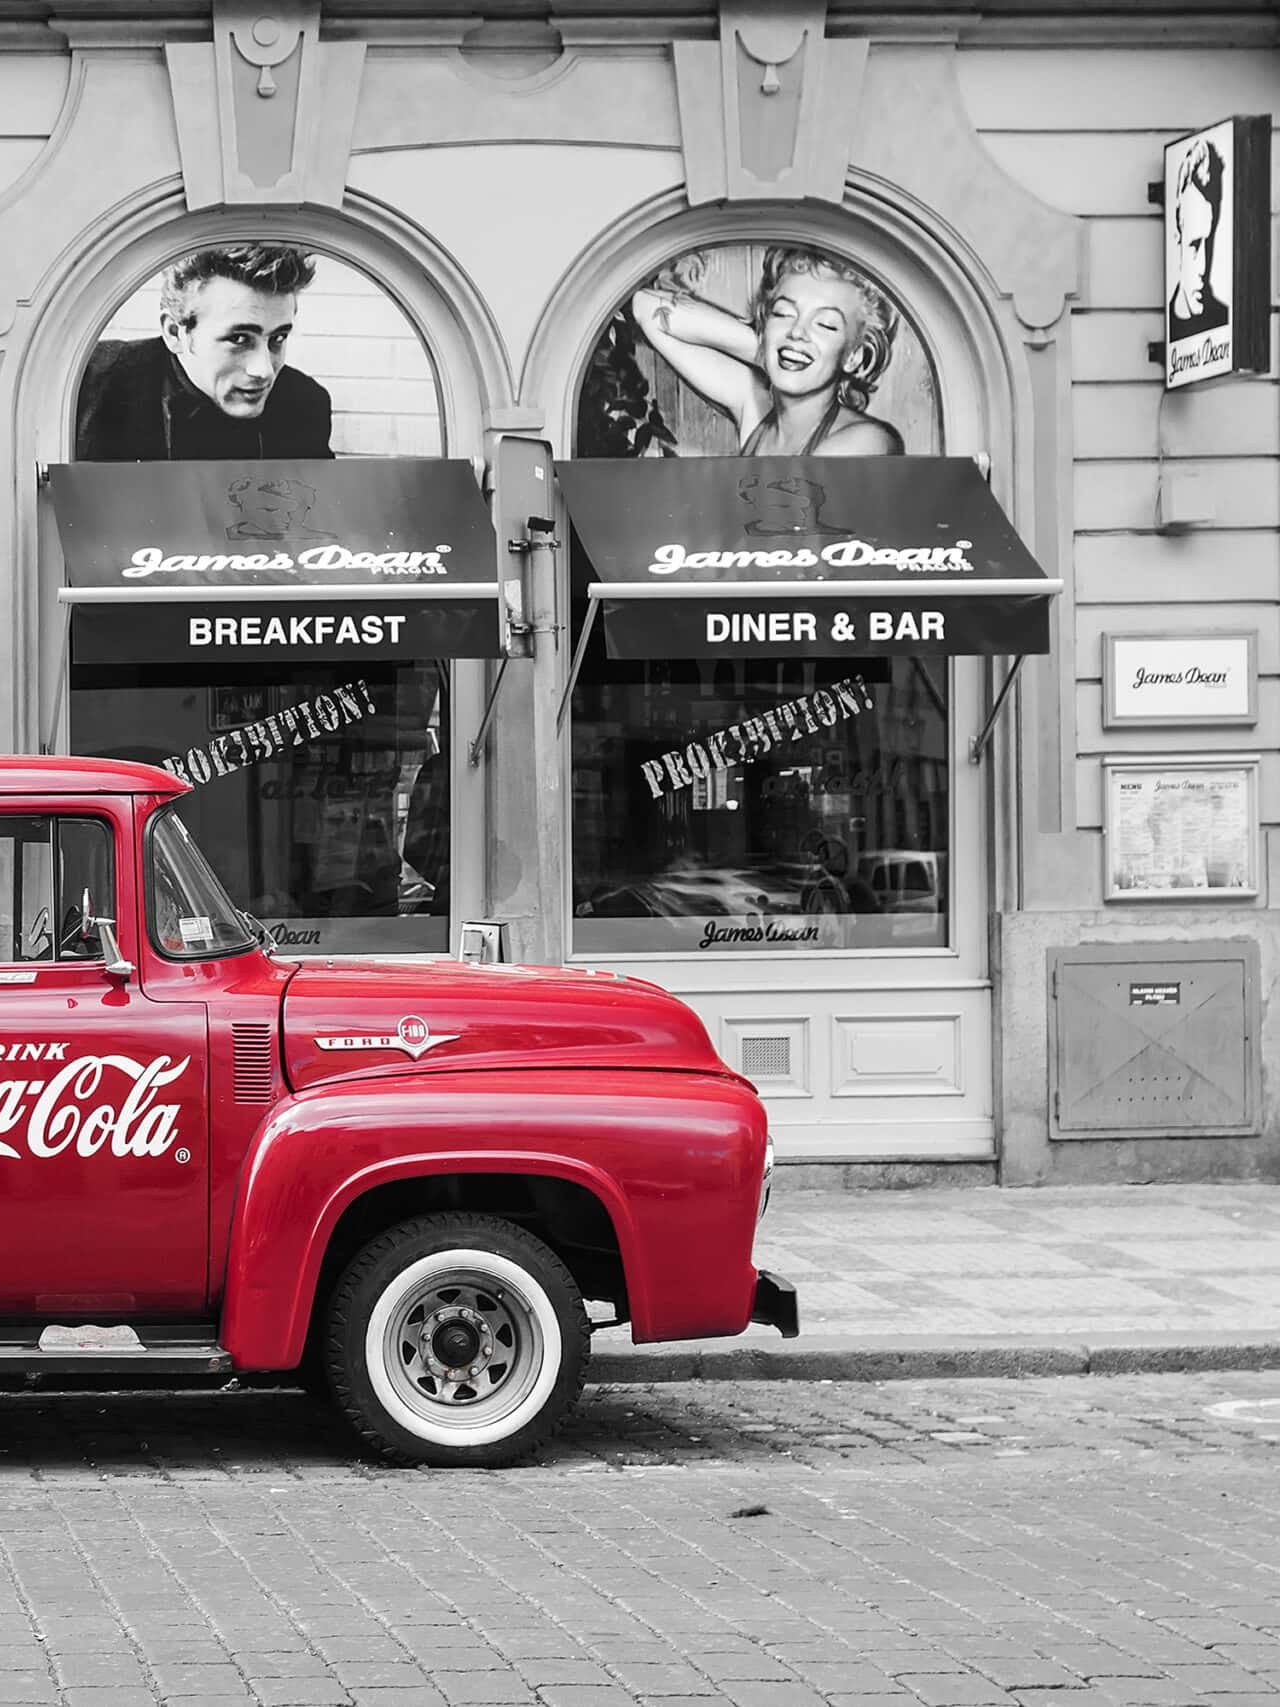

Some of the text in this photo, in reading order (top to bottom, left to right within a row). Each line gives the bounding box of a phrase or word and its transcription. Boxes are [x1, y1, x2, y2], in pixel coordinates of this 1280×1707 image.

[1169, 337, 1230, 382] James Dean
[121, 544, 444, 577] James Dean
[648, 540, 966, 574] James Dean
[189, 615, 406, 646] BREAKFAST
[706, 611, 946, 643] DINER & BAR
[1132, 667, 1227, 689] James Dean
[269, 923, 320, 945] Dean
[699, 920, 819, 949] James Dean
[328, 1038, 390, 1047] FORD
[401, 1024, 425, 1038] F-100
